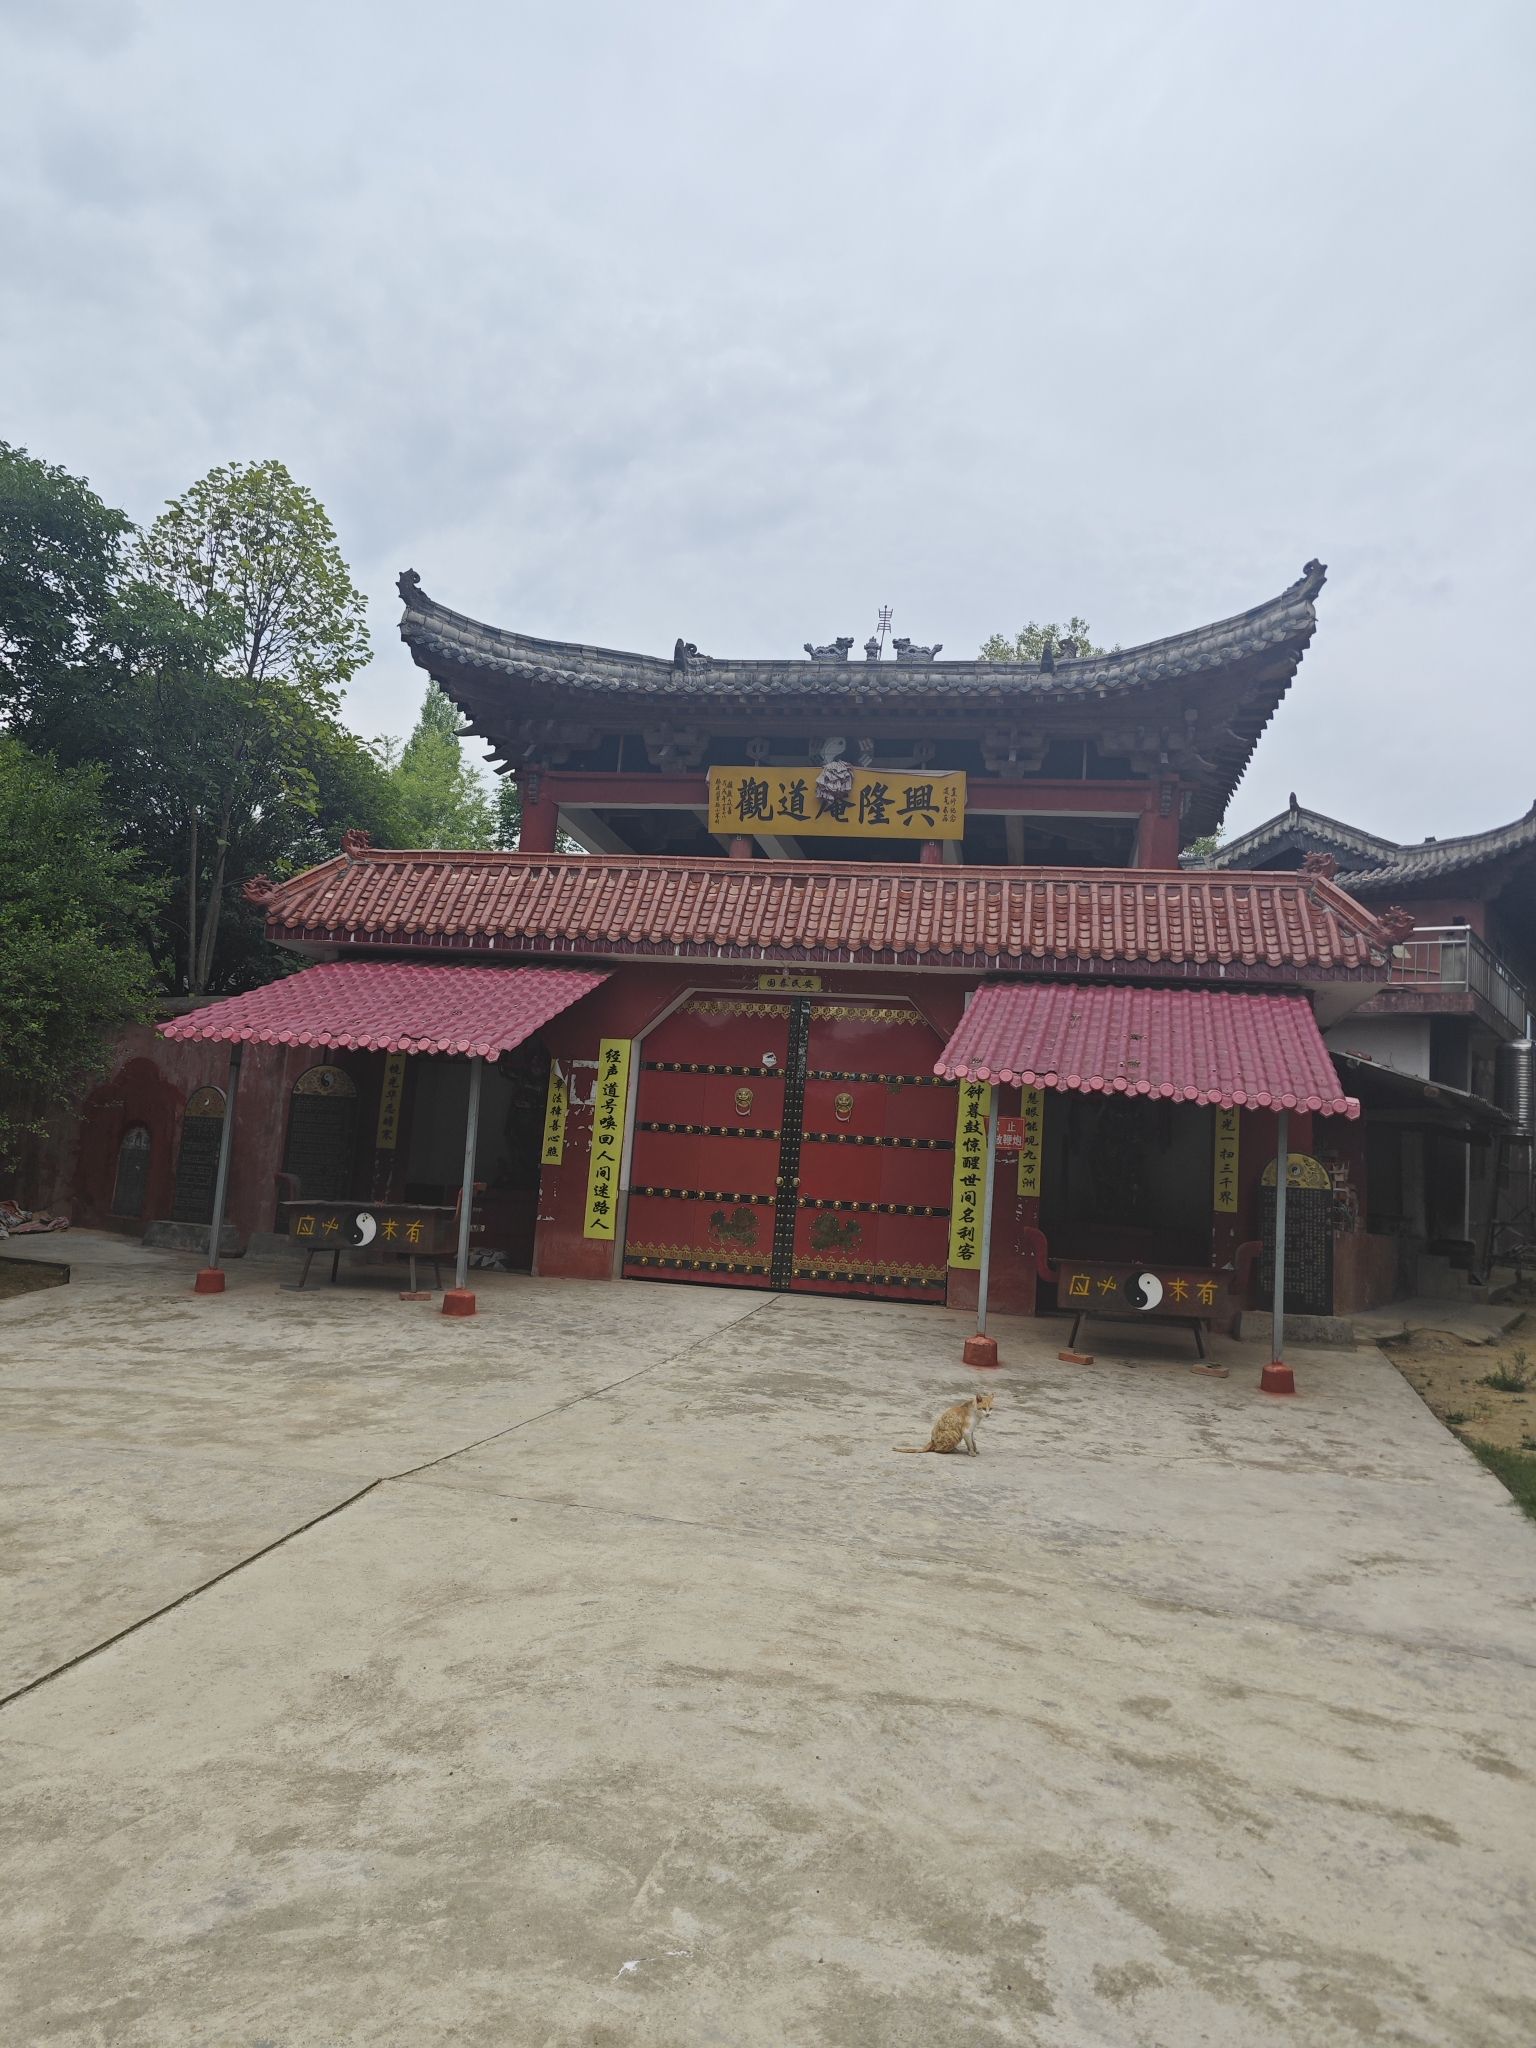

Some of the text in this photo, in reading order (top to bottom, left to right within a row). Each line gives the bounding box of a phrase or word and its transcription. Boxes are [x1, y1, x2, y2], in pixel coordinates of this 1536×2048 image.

[590, 1049, 621, 1230] 经声道号唤回人间迷路人
[957, 1083, 985, 1260] 钟暮鼓惊醒世间名利客
